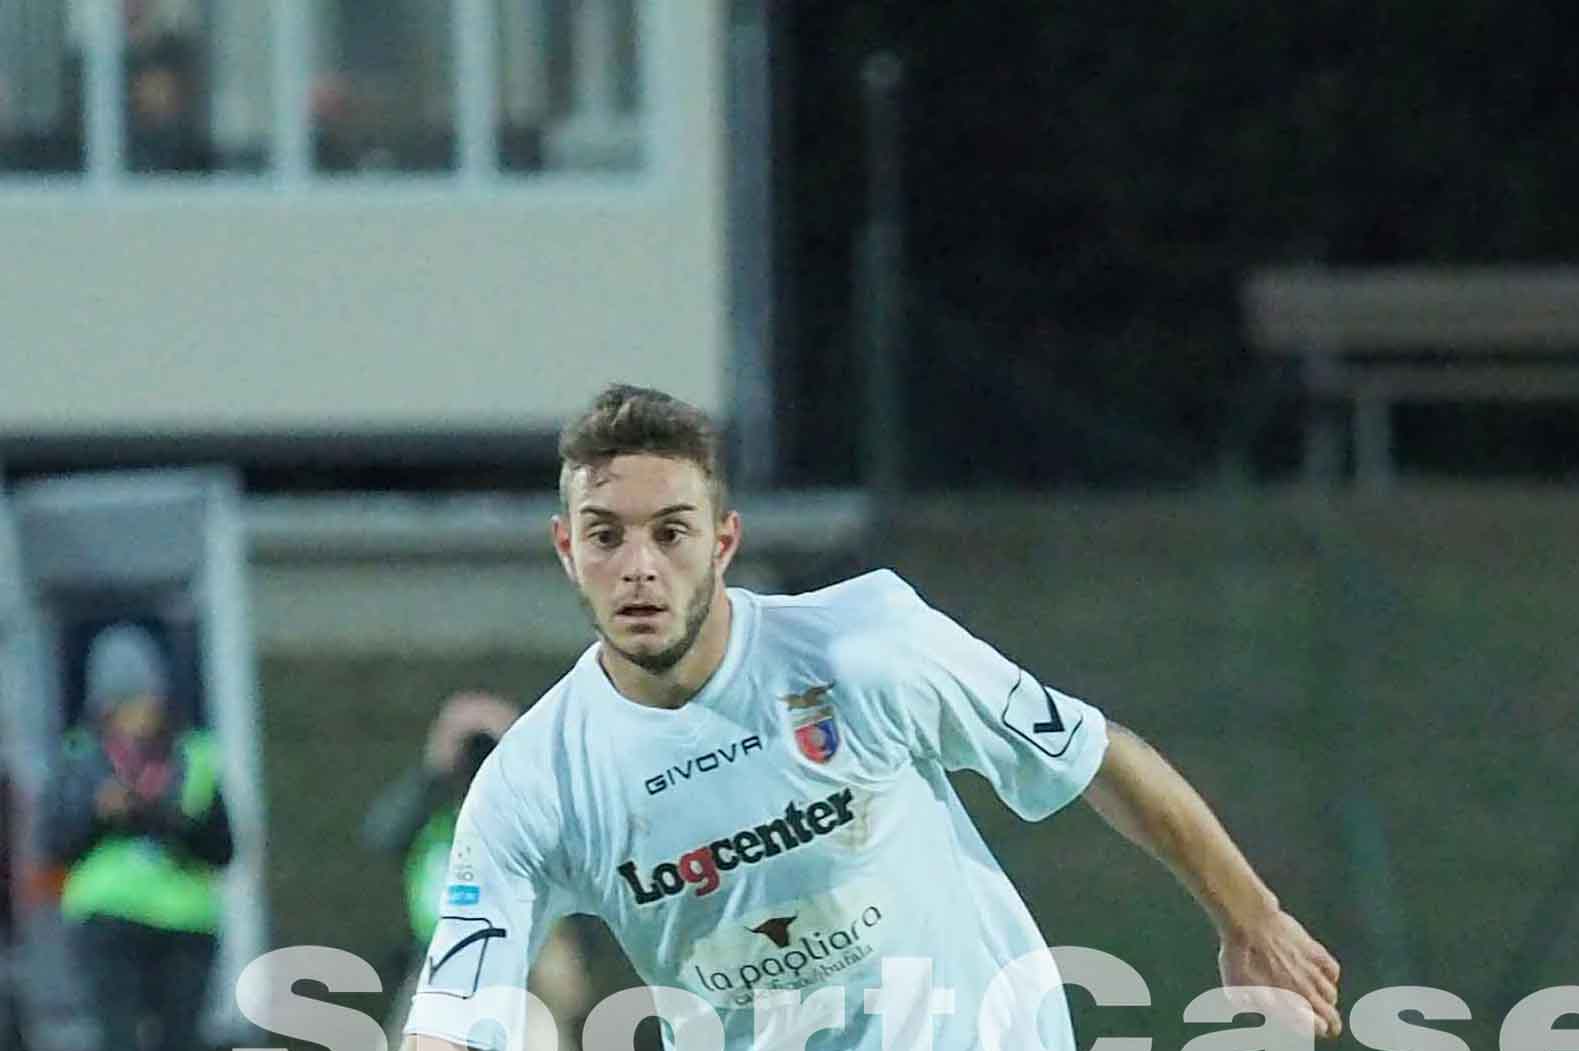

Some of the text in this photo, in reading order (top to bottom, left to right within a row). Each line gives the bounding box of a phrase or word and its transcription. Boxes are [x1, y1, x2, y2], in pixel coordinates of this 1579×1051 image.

[645, 735, 763, 796] GIVOVA
[617, 788, 855, 905] Logcenter
[696, 966, 734, 992] la
